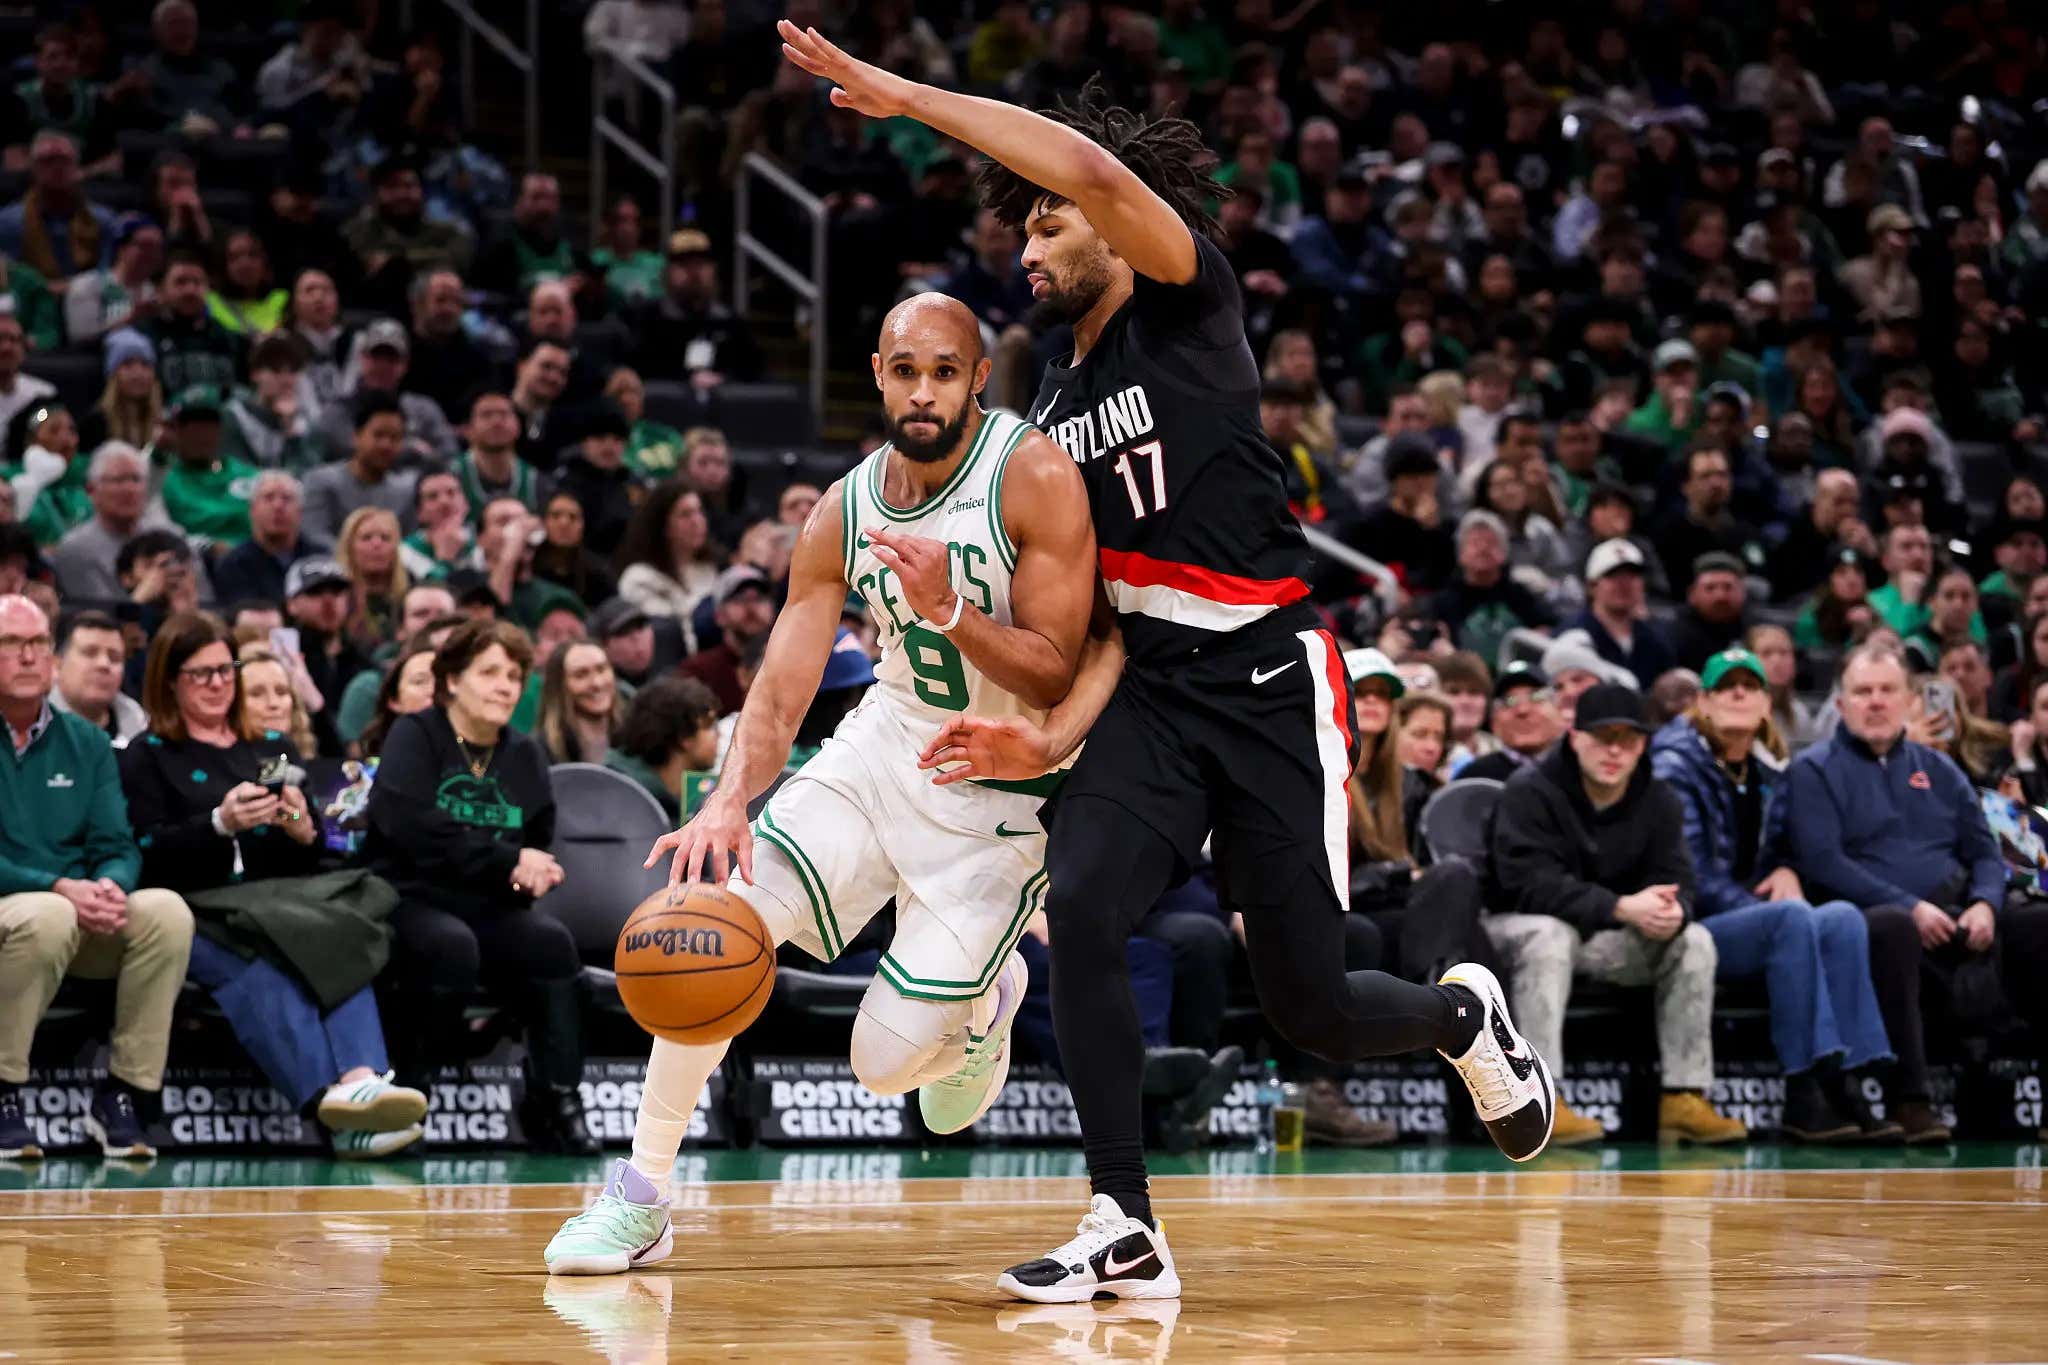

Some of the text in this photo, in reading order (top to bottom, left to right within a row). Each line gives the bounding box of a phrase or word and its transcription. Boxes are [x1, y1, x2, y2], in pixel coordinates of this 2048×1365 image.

[1047, 385, 1154, 464] RTLAND
[1114, 439, 1167, 520] 17
[948, 497, 985, 515] Amica
[904, 625, 970, 712] 9
[625, 928, 725, 958] Wilson
[19, 1087, 94, 1114] TON
[1344, 1079, 1447, 1103] OSTON
[1558, 1079, 1621, 1103] TON
[171, 1115, 303, 1143] CELTICS
[424, 1113, 508, 1140] LTICS
[780, 1108, 902, 1137] CELTICS
